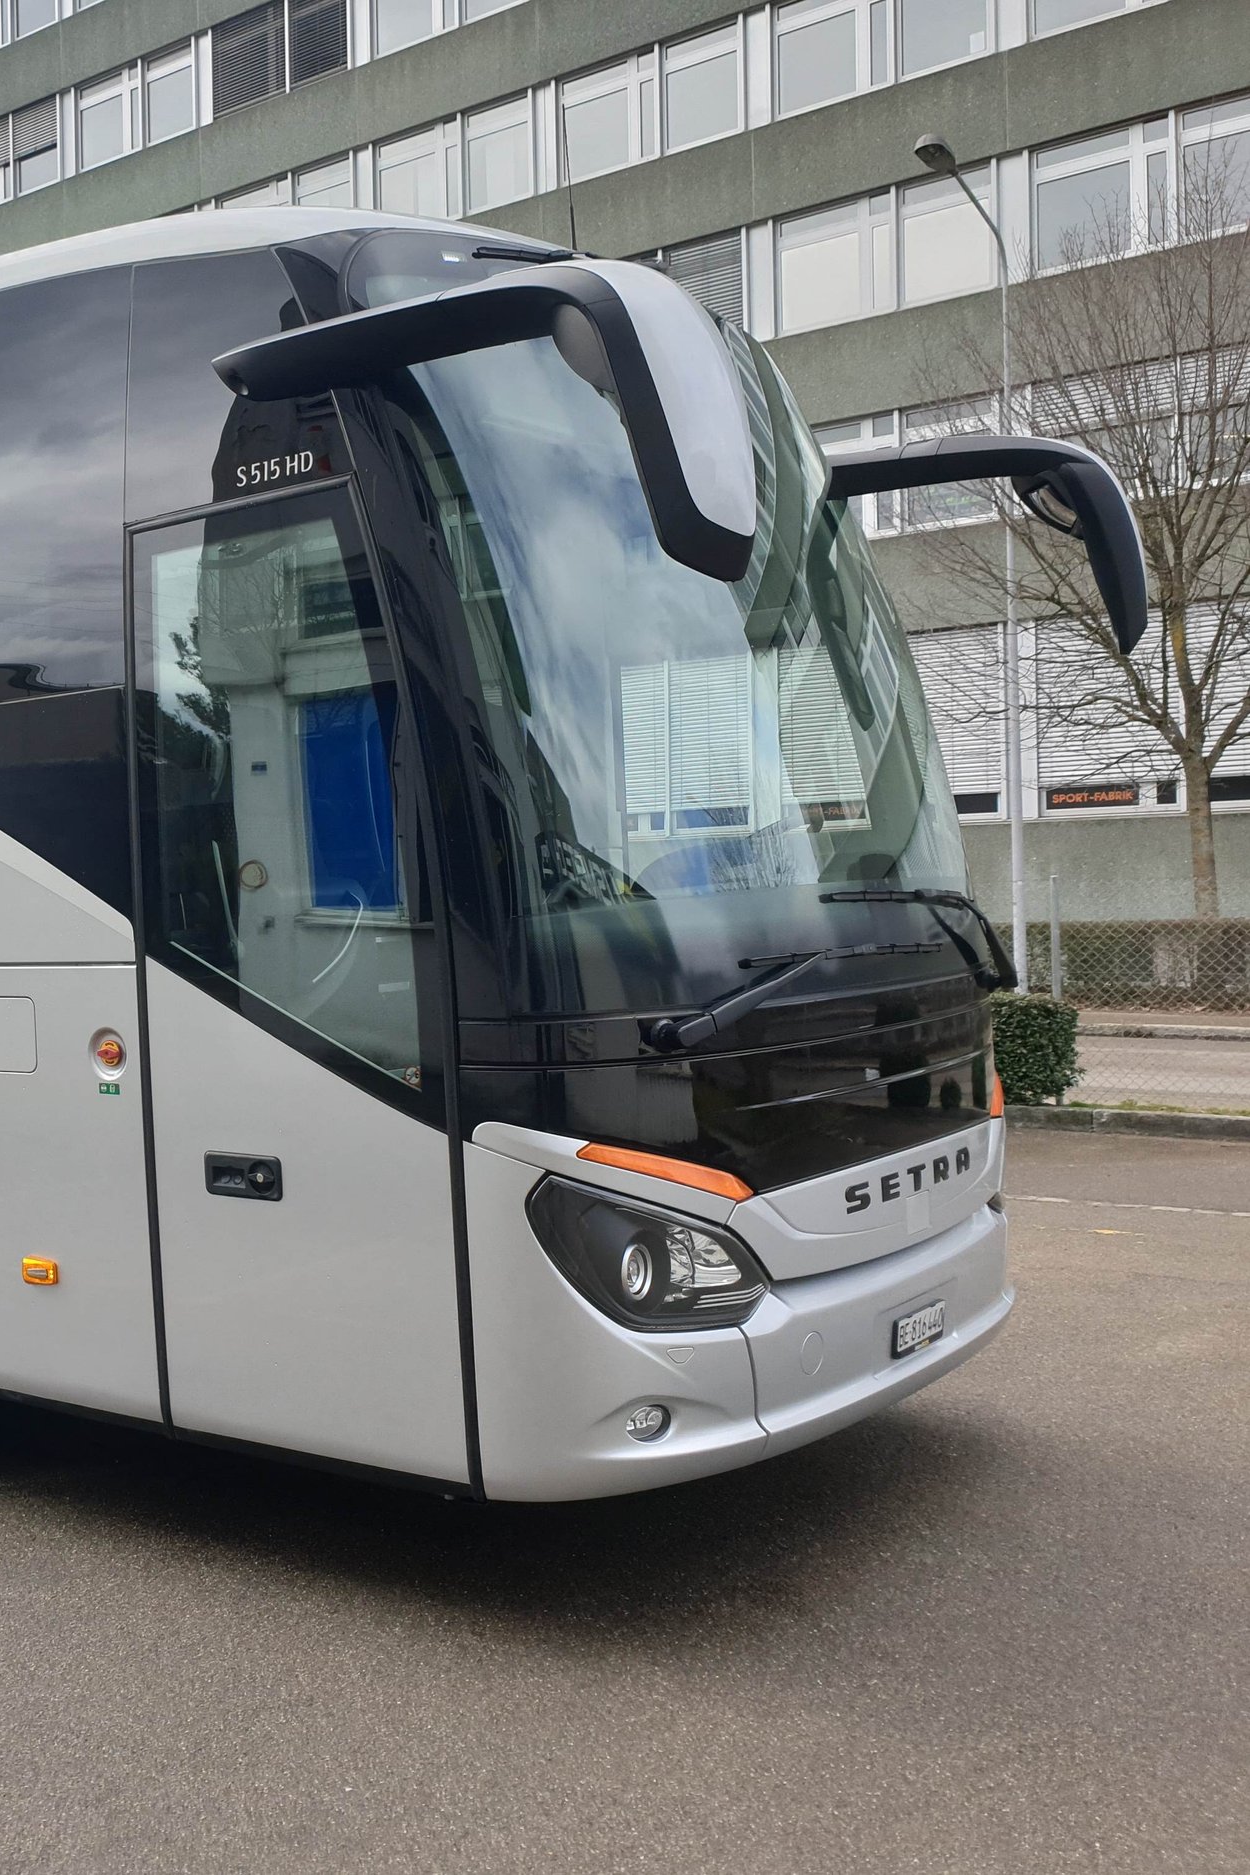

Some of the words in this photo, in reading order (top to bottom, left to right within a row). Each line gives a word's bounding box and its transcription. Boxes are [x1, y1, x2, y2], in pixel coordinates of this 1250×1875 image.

[236, 466, 247, 487] S
[250, 457, 281, 485] 515
[285, 451, 314, 476] HD
[1052, 789, 1134, 804] SPORT-FABRIK
[844, 1147, 971, 1215] SETRA
